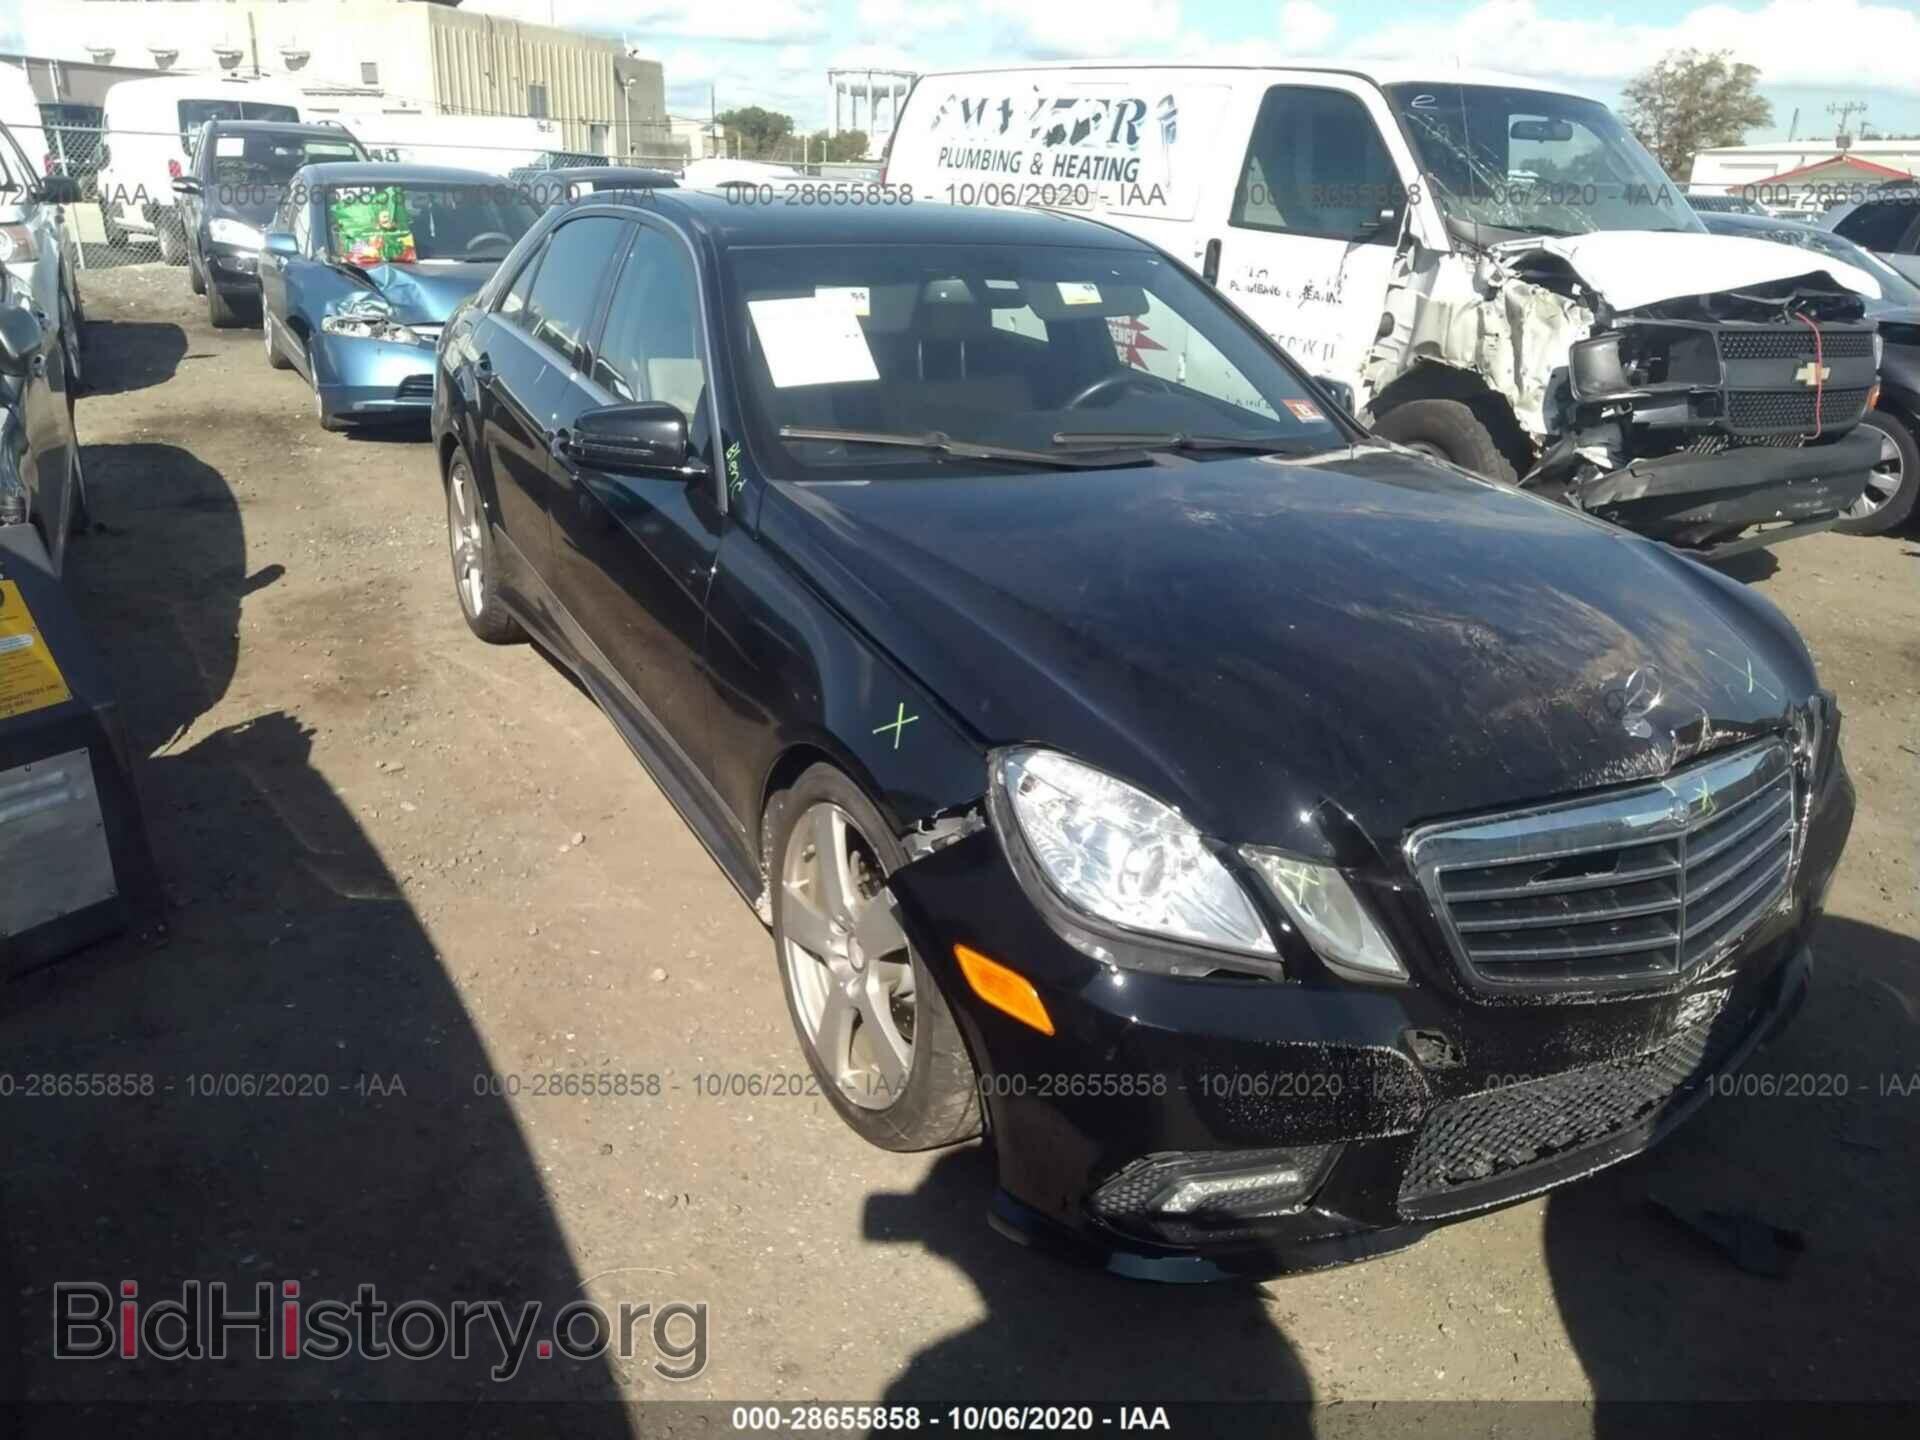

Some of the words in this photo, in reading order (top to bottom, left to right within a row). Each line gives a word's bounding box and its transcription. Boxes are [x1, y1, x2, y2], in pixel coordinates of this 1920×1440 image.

[938, 146, 1023, 174] PLUMBING
[1030, 152, 1043, 176] &
[1052, 154, 1141, 183] HEATING
